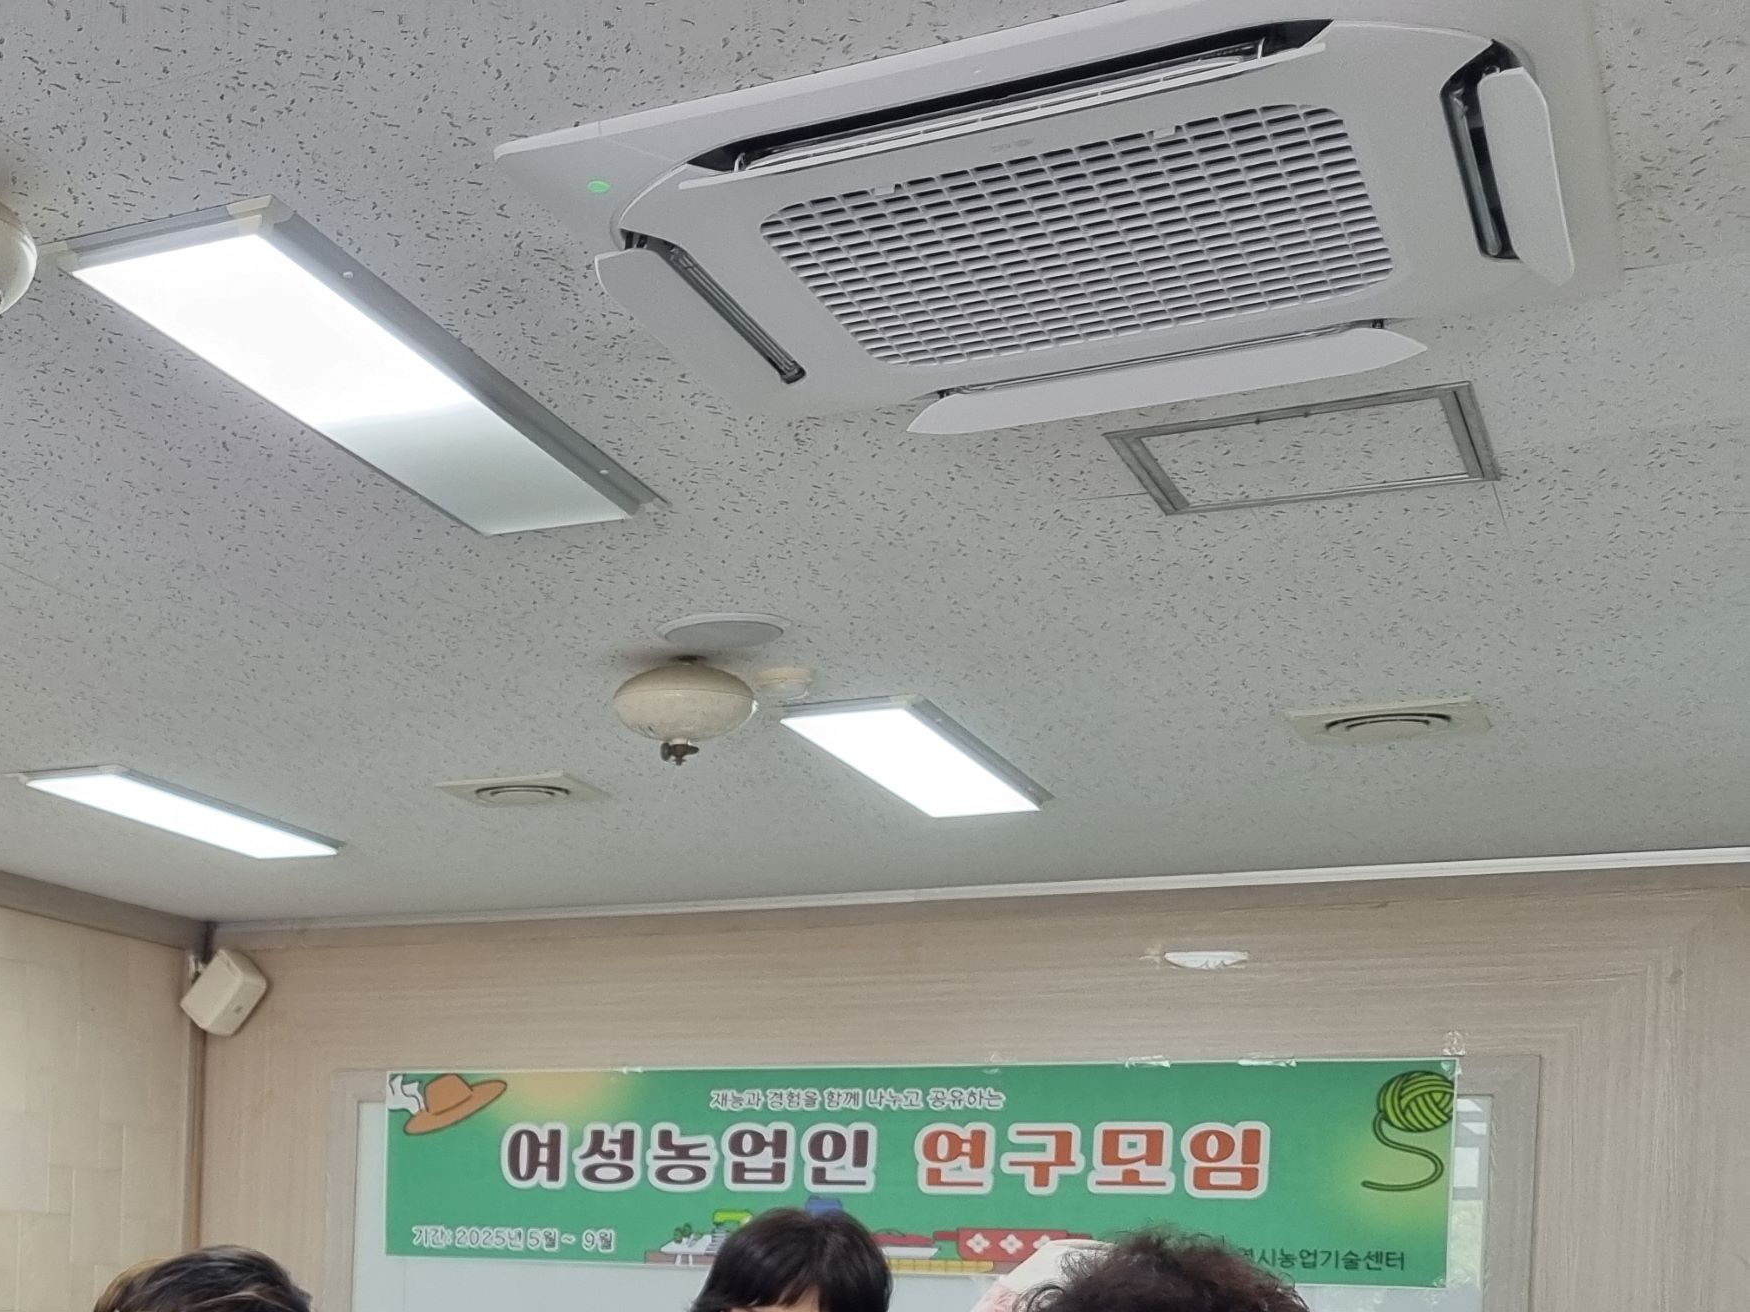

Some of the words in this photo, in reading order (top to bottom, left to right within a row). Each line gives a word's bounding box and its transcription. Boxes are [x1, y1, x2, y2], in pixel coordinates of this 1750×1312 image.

[711, 1090, 762, 1109] 재능과
[768, 1089, 819, 1109] 경험을
[825, 1090, 859, 1109] 함께
[867, 1090, 921, 1109] 나누고
[928, 1089, 1005, 1109] 공유하는
[505, 1127, 871, 1187] 여성농업인
[921, 1127, 1263, 1192] 연구모임
[413, 1227, 452, 1247] 기간:
[456, 1228, 523, 1249] 2025년
[583, 1230, 614, 1250] 9월
